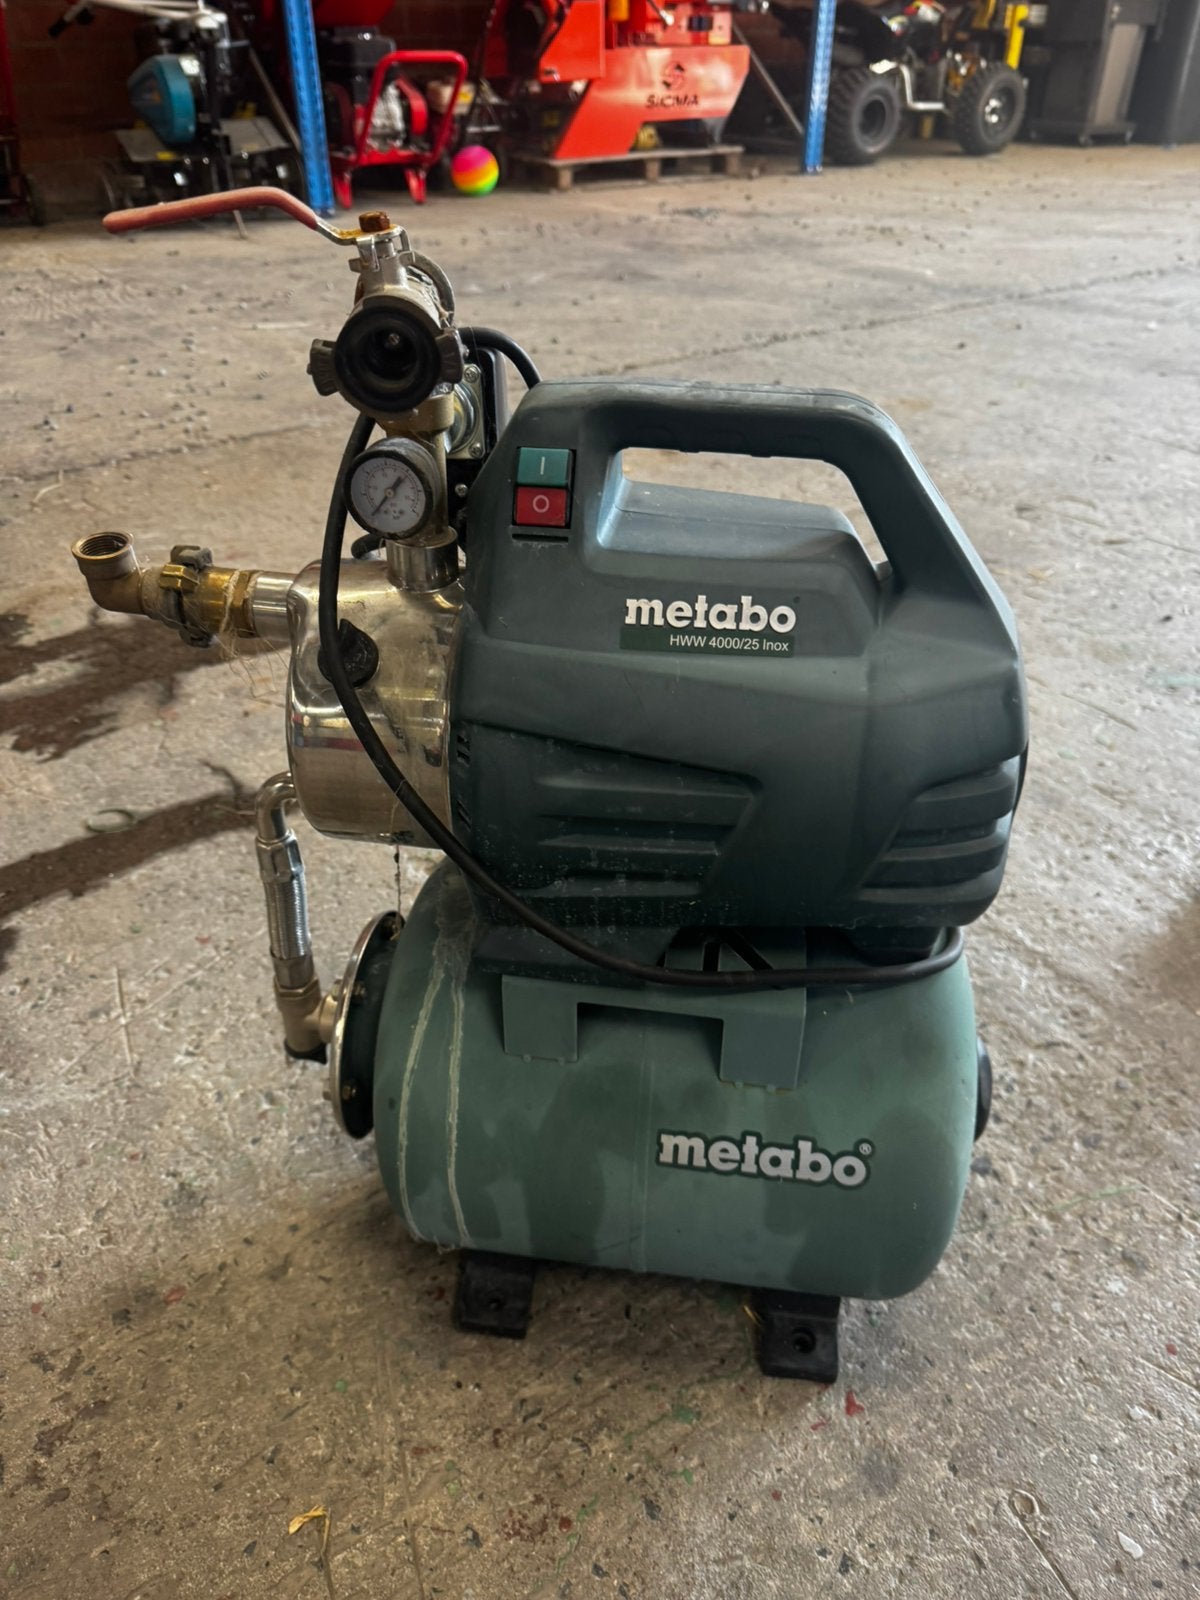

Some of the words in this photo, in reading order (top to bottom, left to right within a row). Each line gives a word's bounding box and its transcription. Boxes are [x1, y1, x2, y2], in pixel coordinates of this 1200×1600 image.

[625, 594, 797, 634] metabo
[669, 634, 707, 648] HWW
[708, 636, 760, 651] 4000/25
[762, 640, 789, 652] Inox
